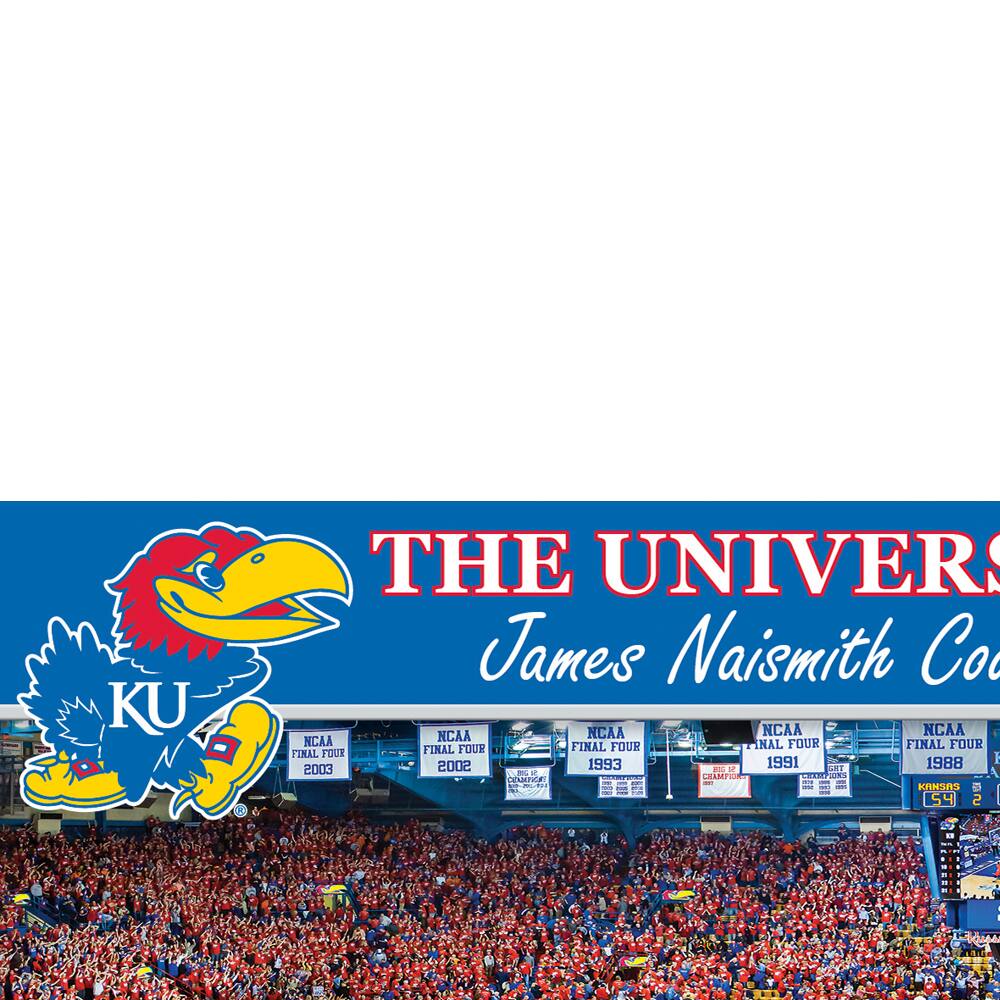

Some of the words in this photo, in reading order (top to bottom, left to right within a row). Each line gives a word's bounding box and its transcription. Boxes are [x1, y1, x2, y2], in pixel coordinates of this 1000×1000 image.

[370, 530, 572, 597] THE
[479, 611, 646, 682] James
[668, 610, 894, 684] Naismith
[108, 681, 190, 729] KU
[587, 727, 625, 739] NCAA
[762, 723, 802, 736] NCAA
[923, 723, 965, 736] NCAA
[304, 735, 333, 747] NCAA
[437, 730, 471, 742] NCAA
[423, 745, 454, 755] FINAL
[458, 743, 485, 754] FOUR
[571, 741, 607, 752] FINAL
[610, 741, 640, 752] FOUR
[788, 738, 820, 749] FOUR
[906, 739, 946, 750] FINAL
[949, 739, 983, 749] FOUR
[292, 749, 319, 758] FINAL
[322, 748, 345, 758] FOUR
[437, 760, 471, 772] 2002
[588, 758, 622, 770] 1993
[767, 756, 799, 769] 1991
[927, 756, 963, 770] 1988
[304, 764, 333, 775] 2003
[918, 783, 960, 791] KANSAS
[931, 793, 954, 806] 54
[972, 794, 982, 806] 2
